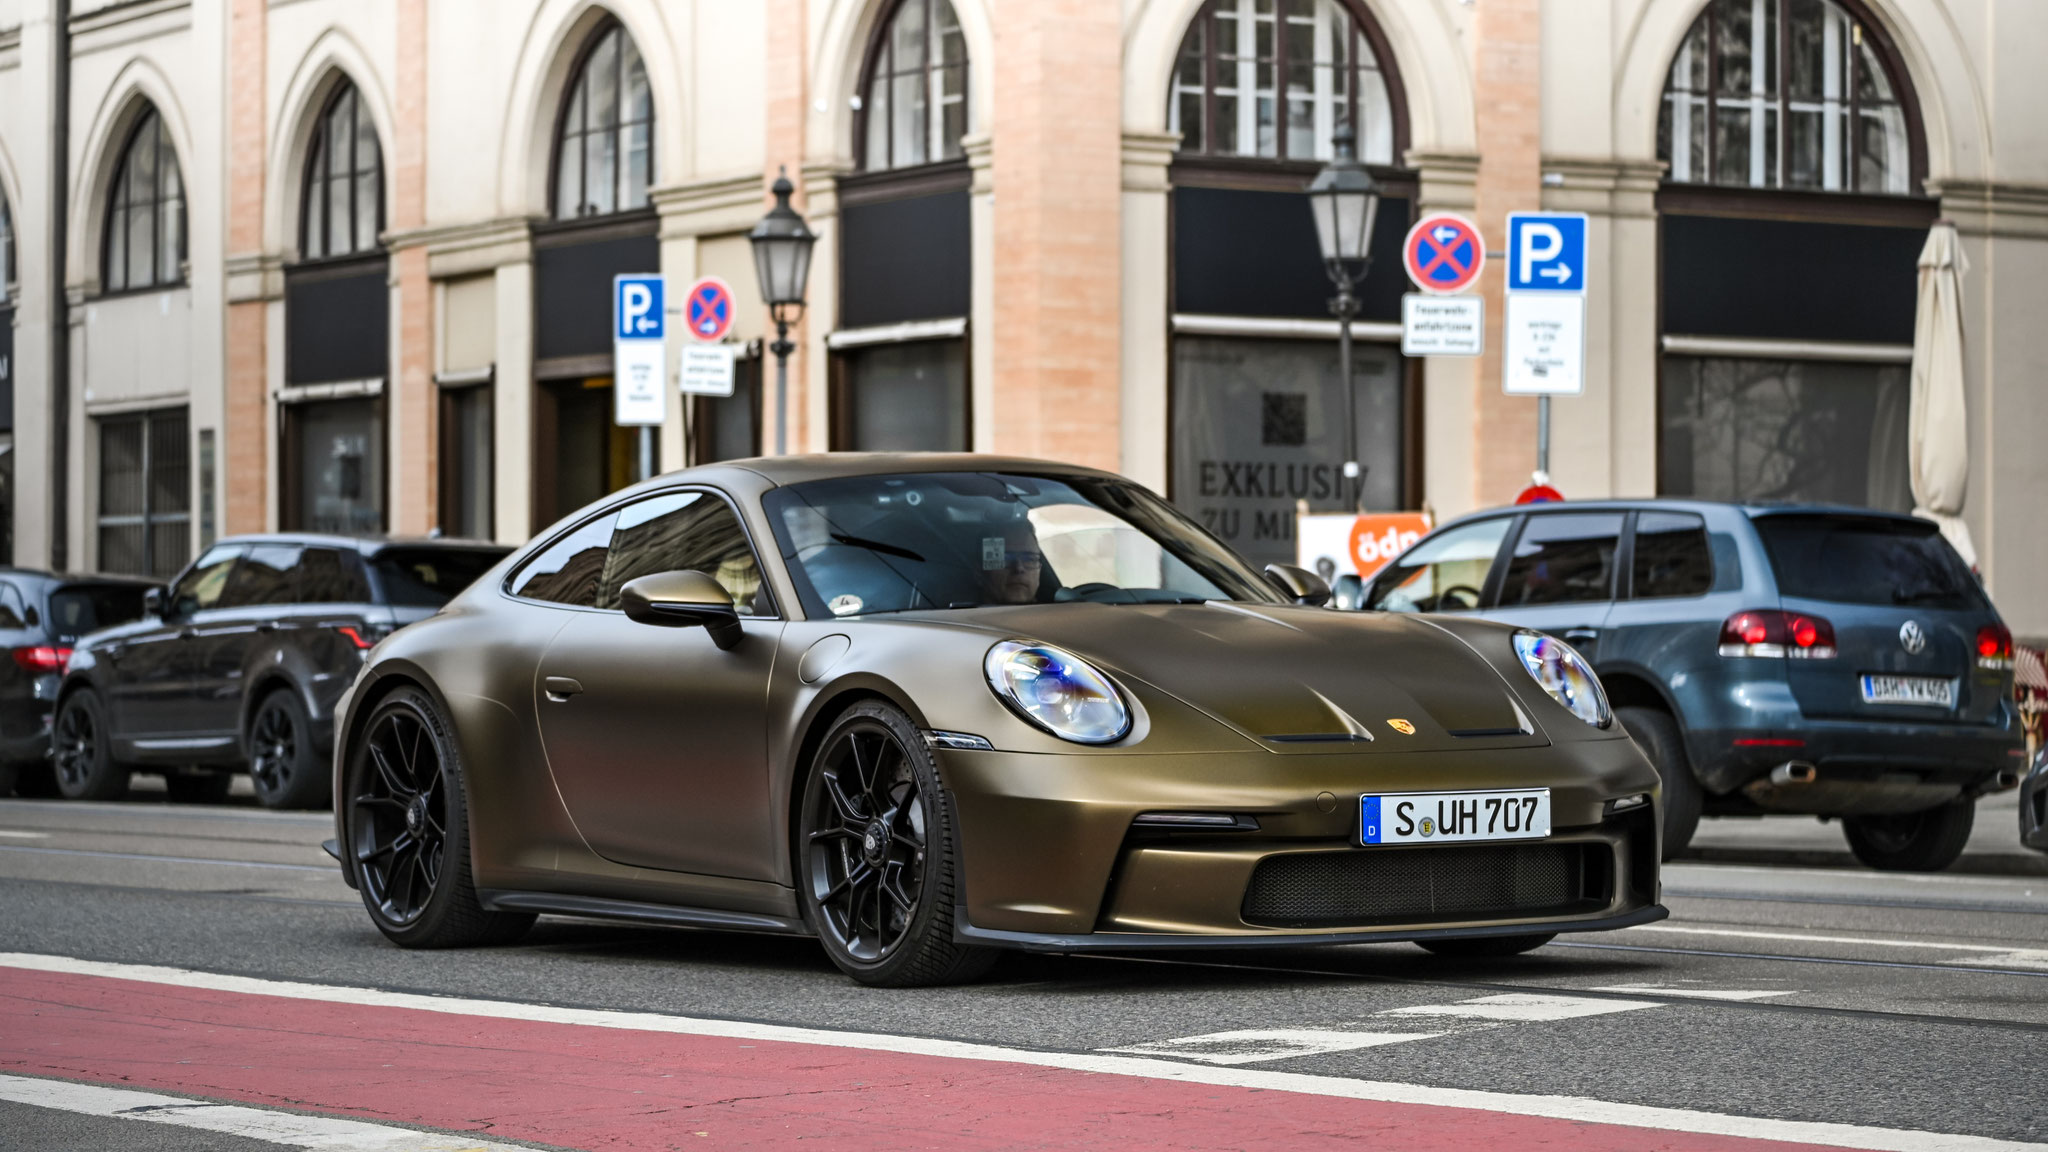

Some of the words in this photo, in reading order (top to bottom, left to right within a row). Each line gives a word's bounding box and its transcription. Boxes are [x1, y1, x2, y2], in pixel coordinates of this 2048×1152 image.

[1519, 222, 1563, 284] P
[622, 282, 653, 335] P
[1368, 825, 1376, 837] D
[1395, 801, 1415, 836] S
[1438, 799, 1478, 835] UH
[1485, 796, 1538, 834] 707
